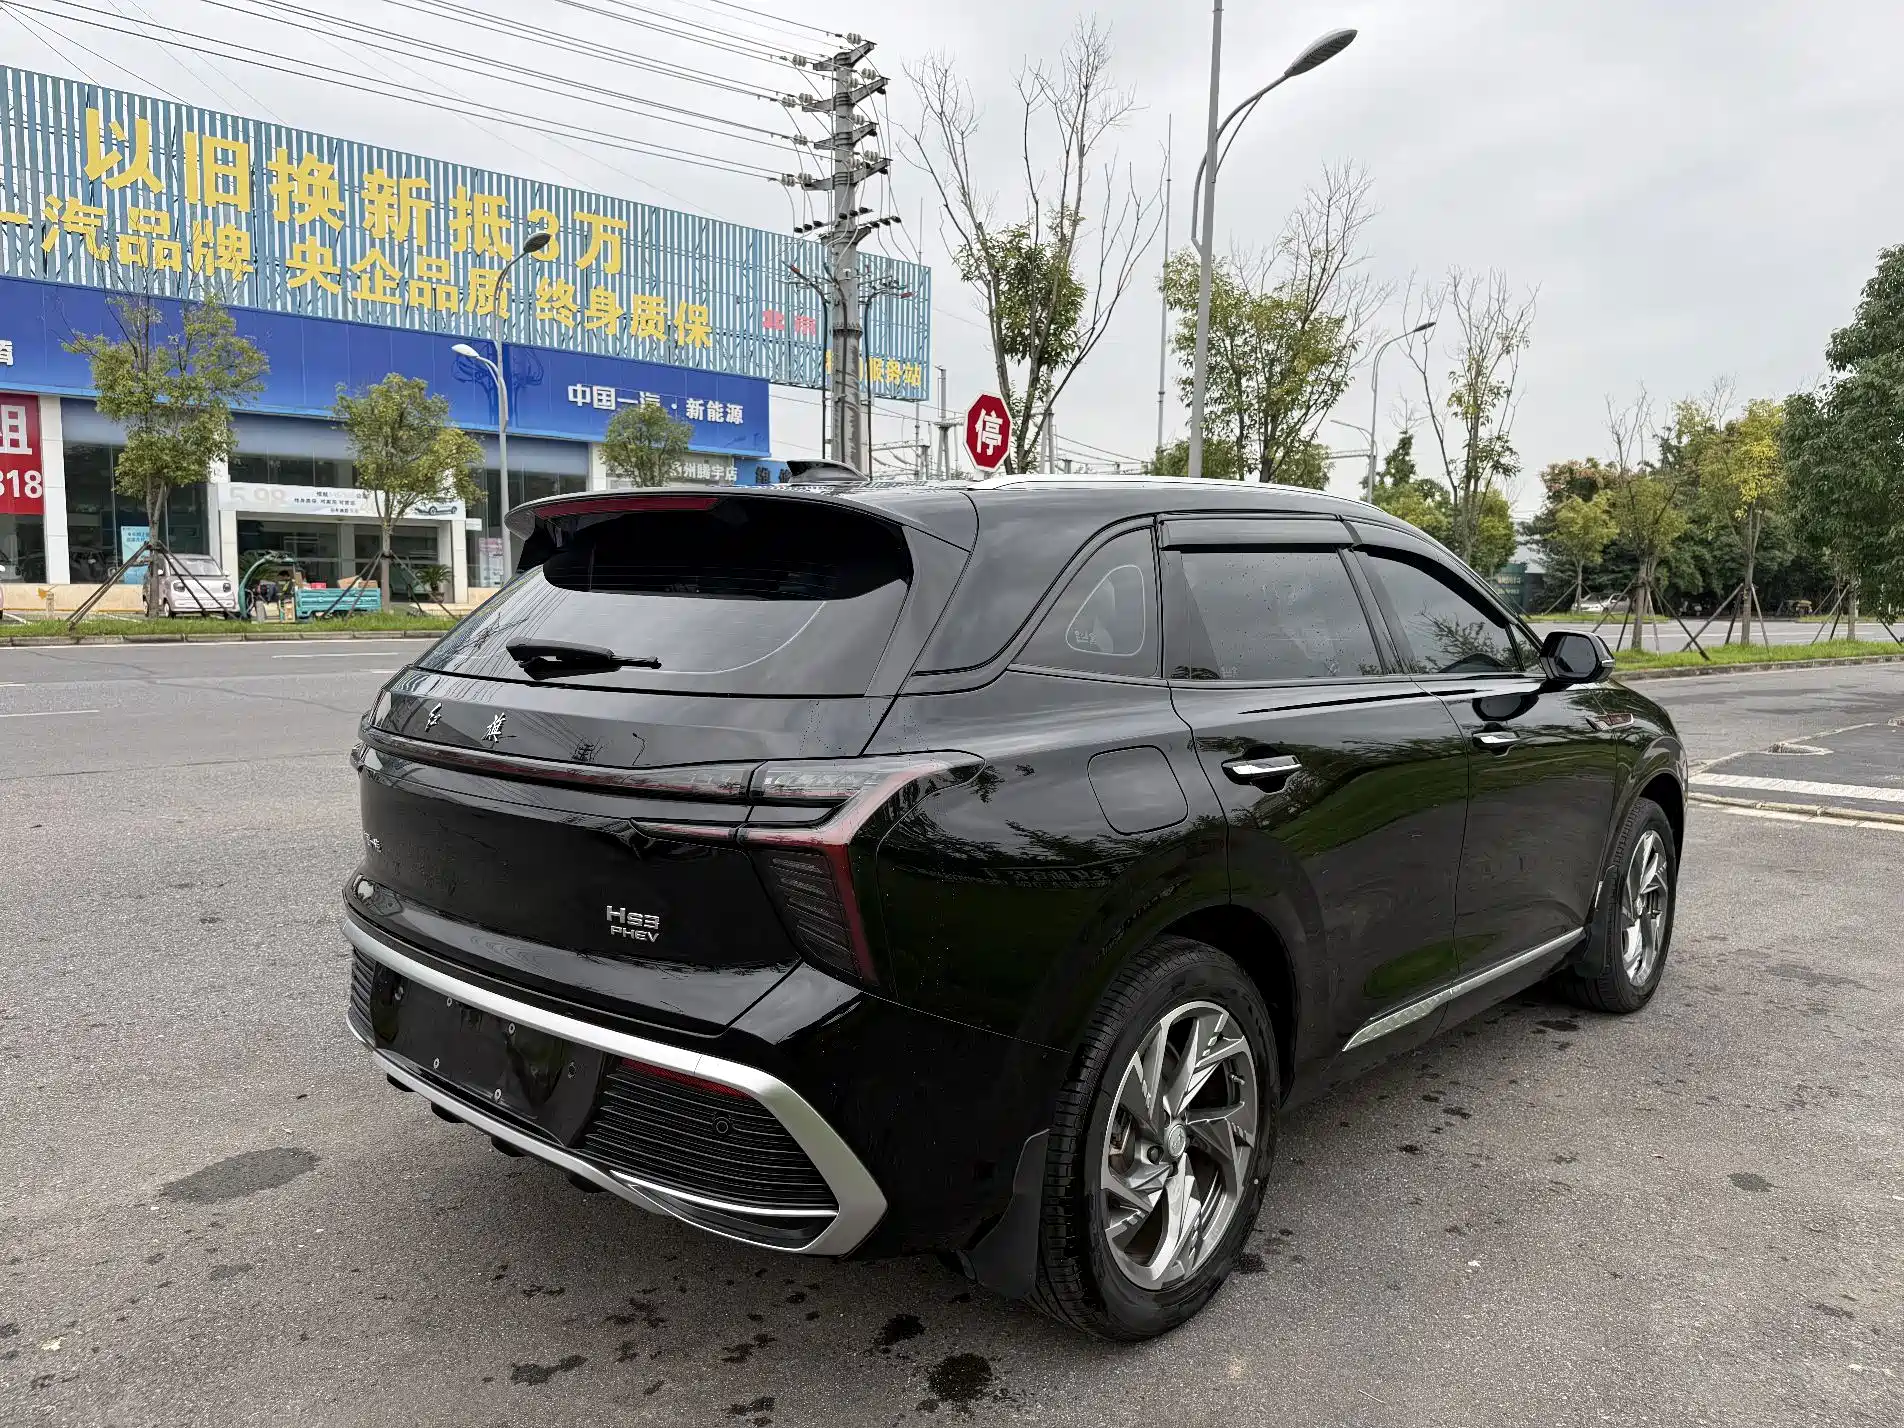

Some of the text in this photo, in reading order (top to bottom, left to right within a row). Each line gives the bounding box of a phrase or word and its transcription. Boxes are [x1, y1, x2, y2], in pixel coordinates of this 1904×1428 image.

[84, 108, 628, 275] 以旧换新抵3万
[535, 276, 713, 348] 终身质保
[974, 408, 1003, 456] 停
[610, 925, 660, 943] PHEV
